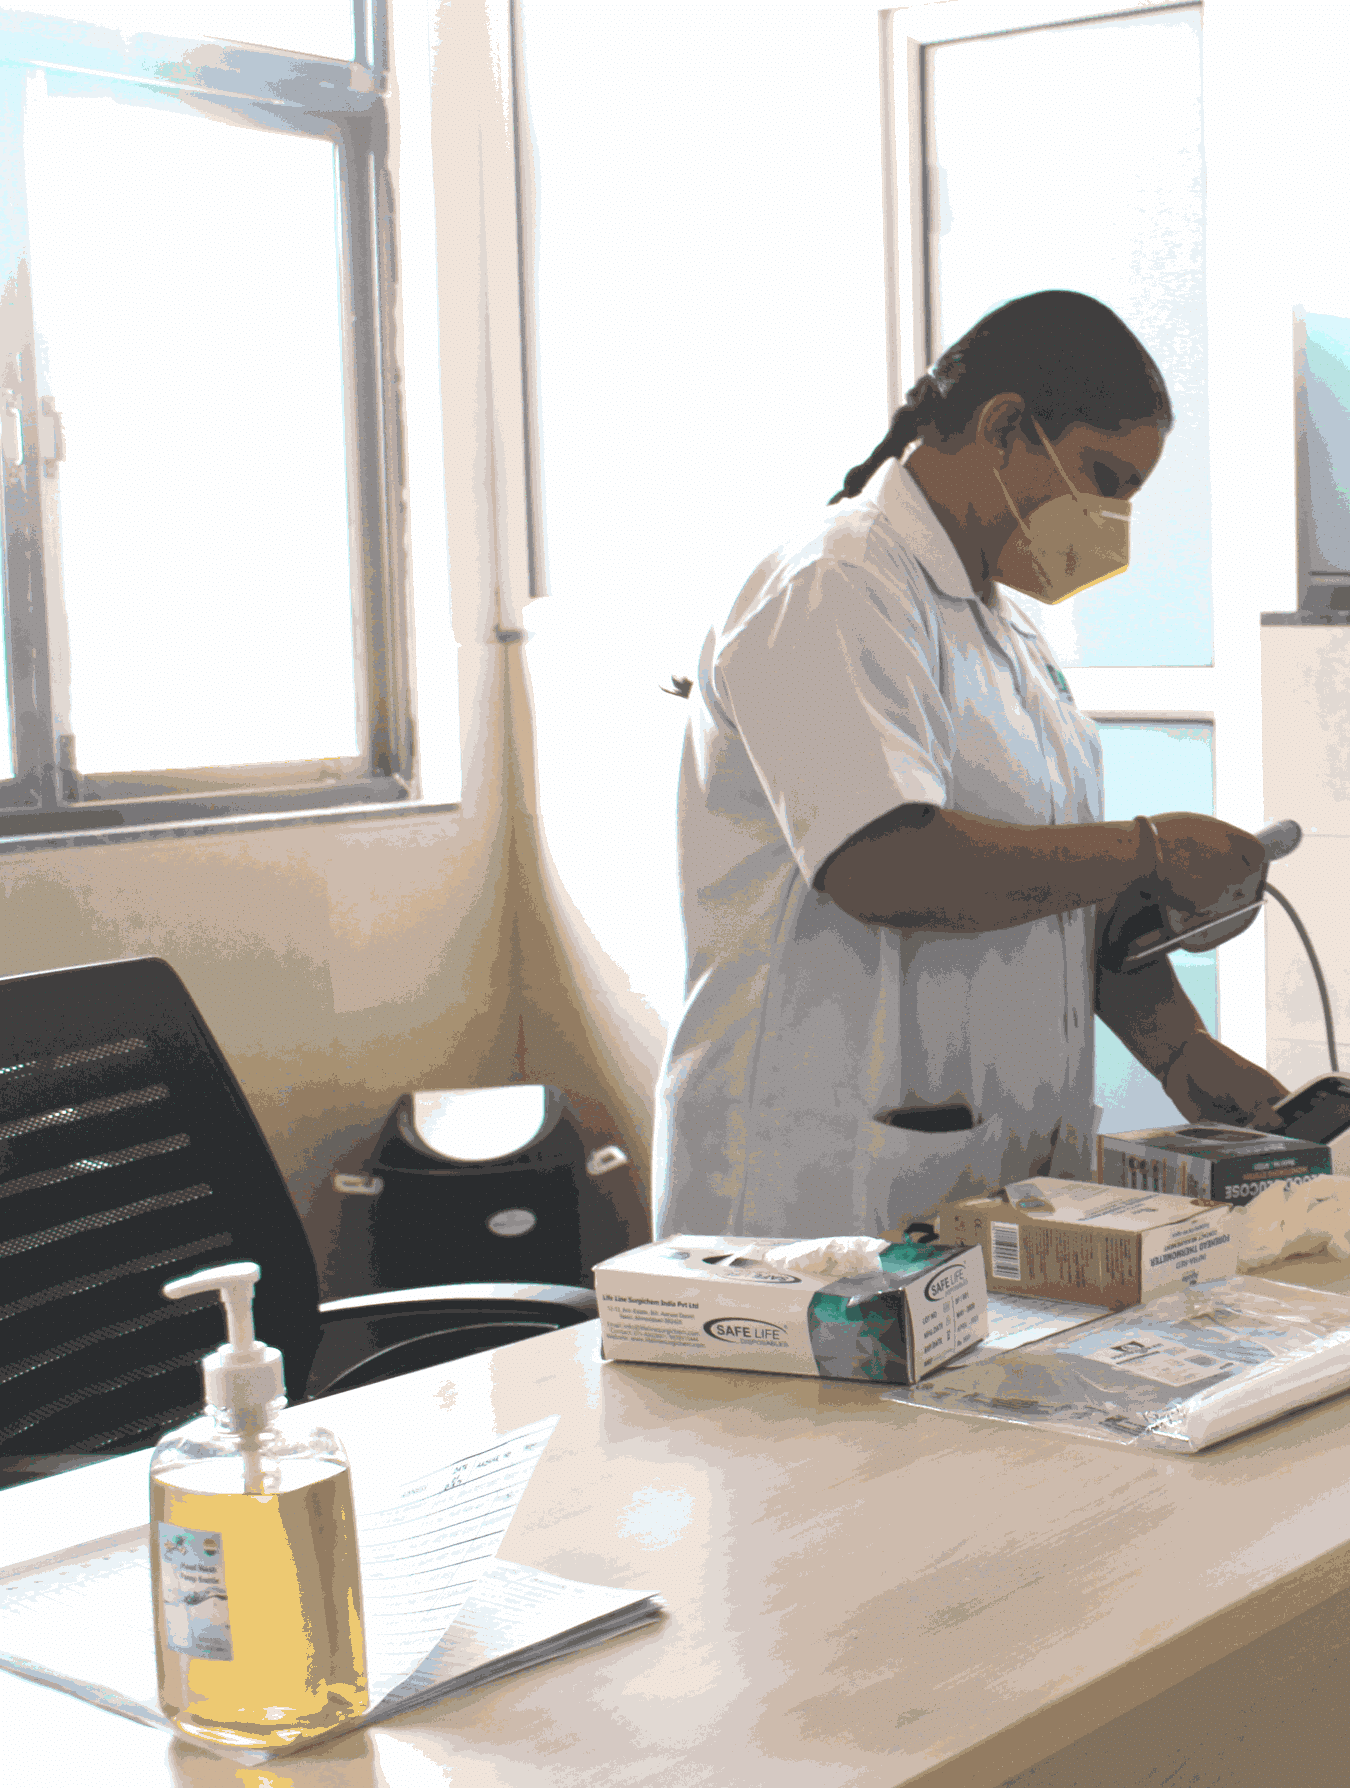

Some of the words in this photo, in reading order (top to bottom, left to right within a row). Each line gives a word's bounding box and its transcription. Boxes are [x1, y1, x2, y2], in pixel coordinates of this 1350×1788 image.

[1225, 1180, 1274, 1199] UCOSE
[1199, 1233, 1231, 1251] FOREHEAD
[1149, 1244, 1198, 1268] THERMOMETER
[931, 1277, 950, 1296] SAFE
[950, 1269, 964, 1286] LIFE
[660, 1299, 677, 1308] India
[677, 1301, 689, 1309] Pvt
[688, 1302, 700, 1310] Ltd
[716, 1324, 752, 1339] SAFE
[754, 1328, 781, 1341] LIFE
